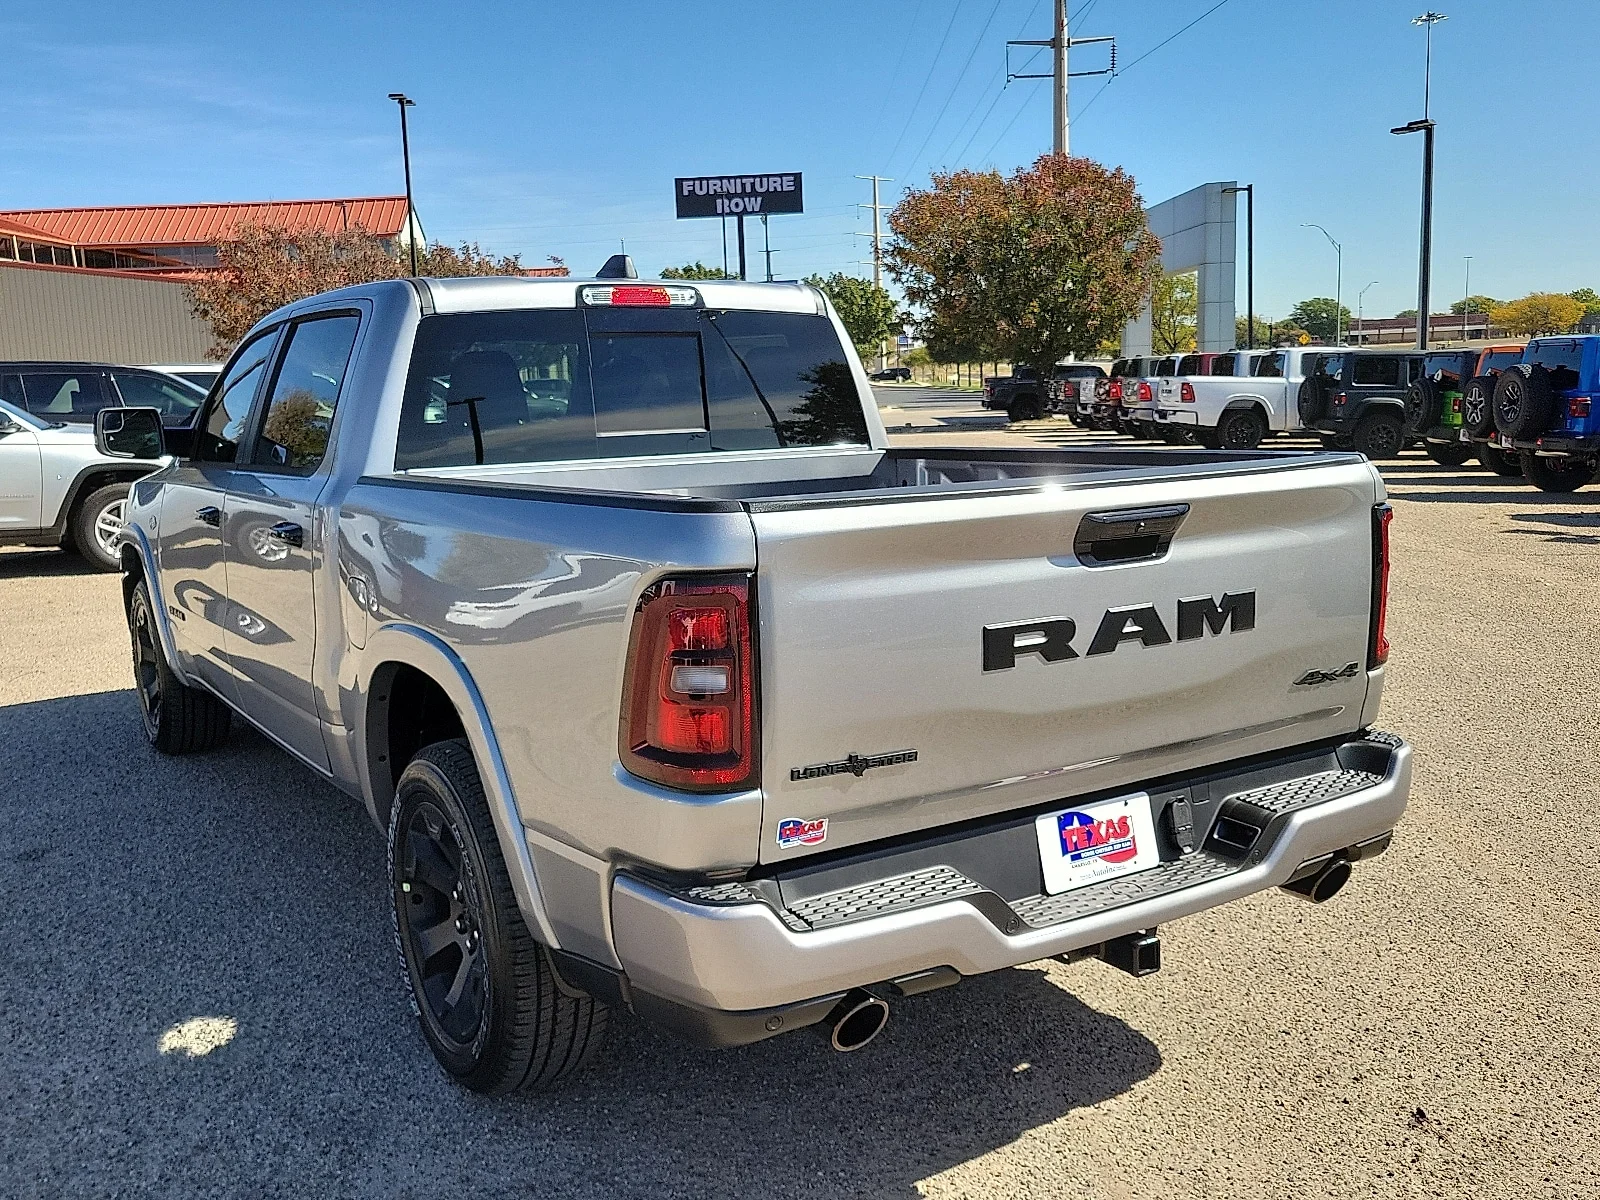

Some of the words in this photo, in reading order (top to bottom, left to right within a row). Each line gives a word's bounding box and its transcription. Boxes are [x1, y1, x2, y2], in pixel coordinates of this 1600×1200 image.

[682, 176, 795, 196] FURNITURE
[716, 197, 762, 214] ROW
[982, 589, 1256, 673] RAM
[790, 764, 850, 781] LONE
[781, 821, 824, 838] TEXAS
[1062, 816, 1130, 852] TEXAS
